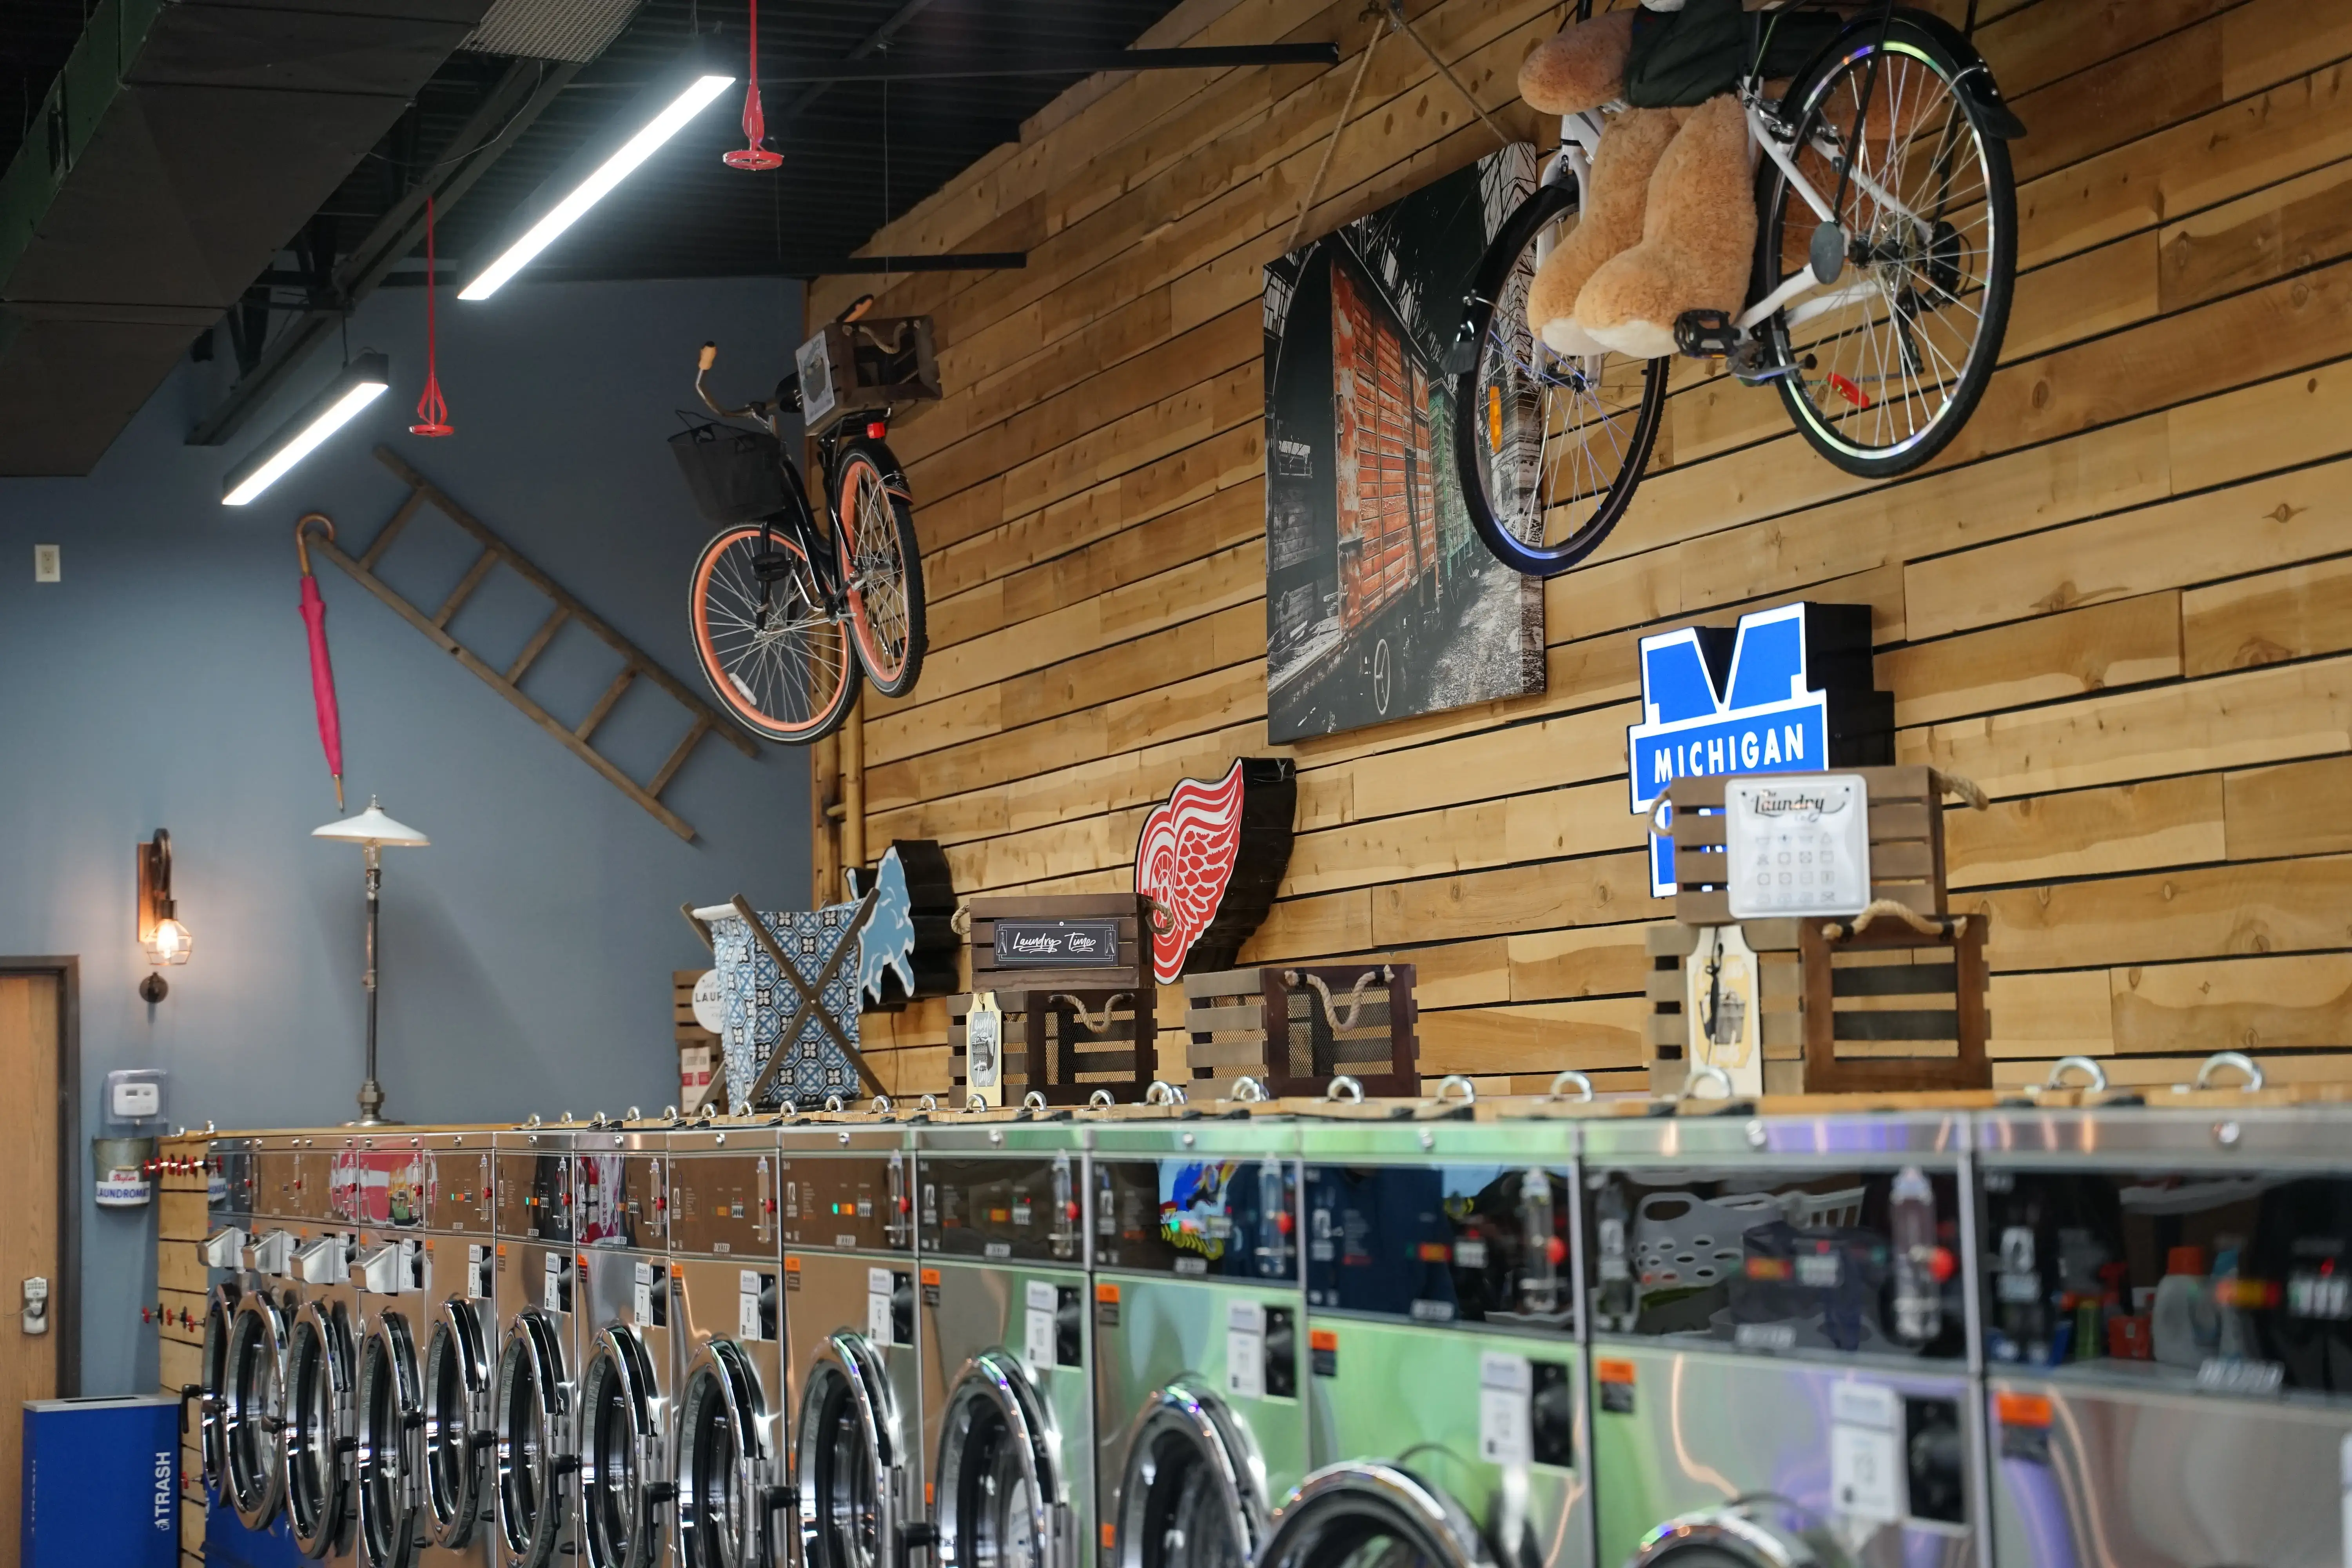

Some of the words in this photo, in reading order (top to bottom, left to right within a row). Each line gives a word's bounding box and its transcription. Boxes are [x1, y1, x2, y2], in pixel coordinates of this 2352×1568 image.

[1654, 723, 1803, 784] MICHIGAN
[1754, 794, 1845, 818] Laundry
[1013, 932, 1062, 953] Laundry
[1064, 932, 1096, 953] Time
[970, 1008, 997, 1041] Laundry
[974, 1059, 992, 1091] Time
[713, 1243, 730, 1252] DEXTER
[640, 1296, 644, 1311] 7
[747, 1307, 750, 1323] 8
[154, 1452, 171, 1518] TRASH
